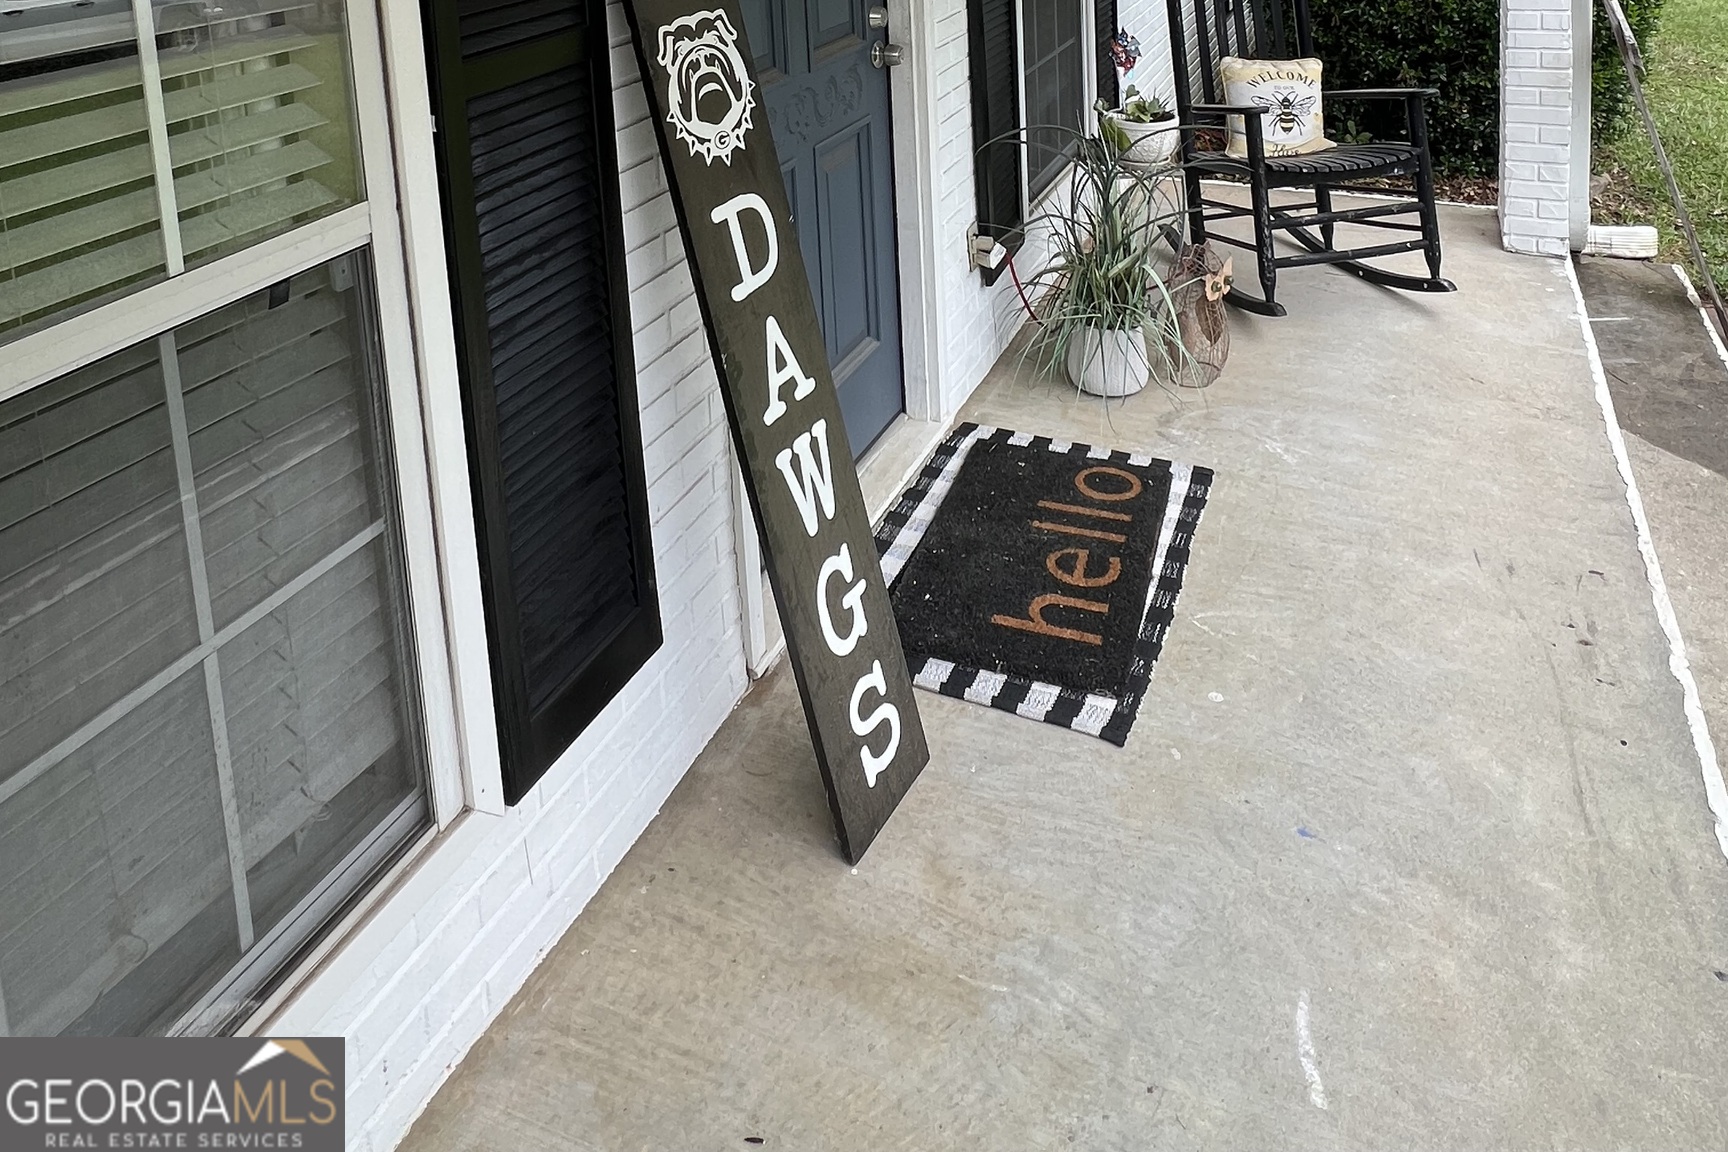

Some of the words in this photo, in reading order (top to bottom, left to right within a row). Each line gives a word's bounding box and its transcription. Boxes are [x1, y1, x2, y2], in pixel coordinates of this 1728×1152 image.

[1246, 70, 1317, 90] WELCOME
[711, 192, 901, 789] DAWGS
[991, 466, 1143, 646] hello
